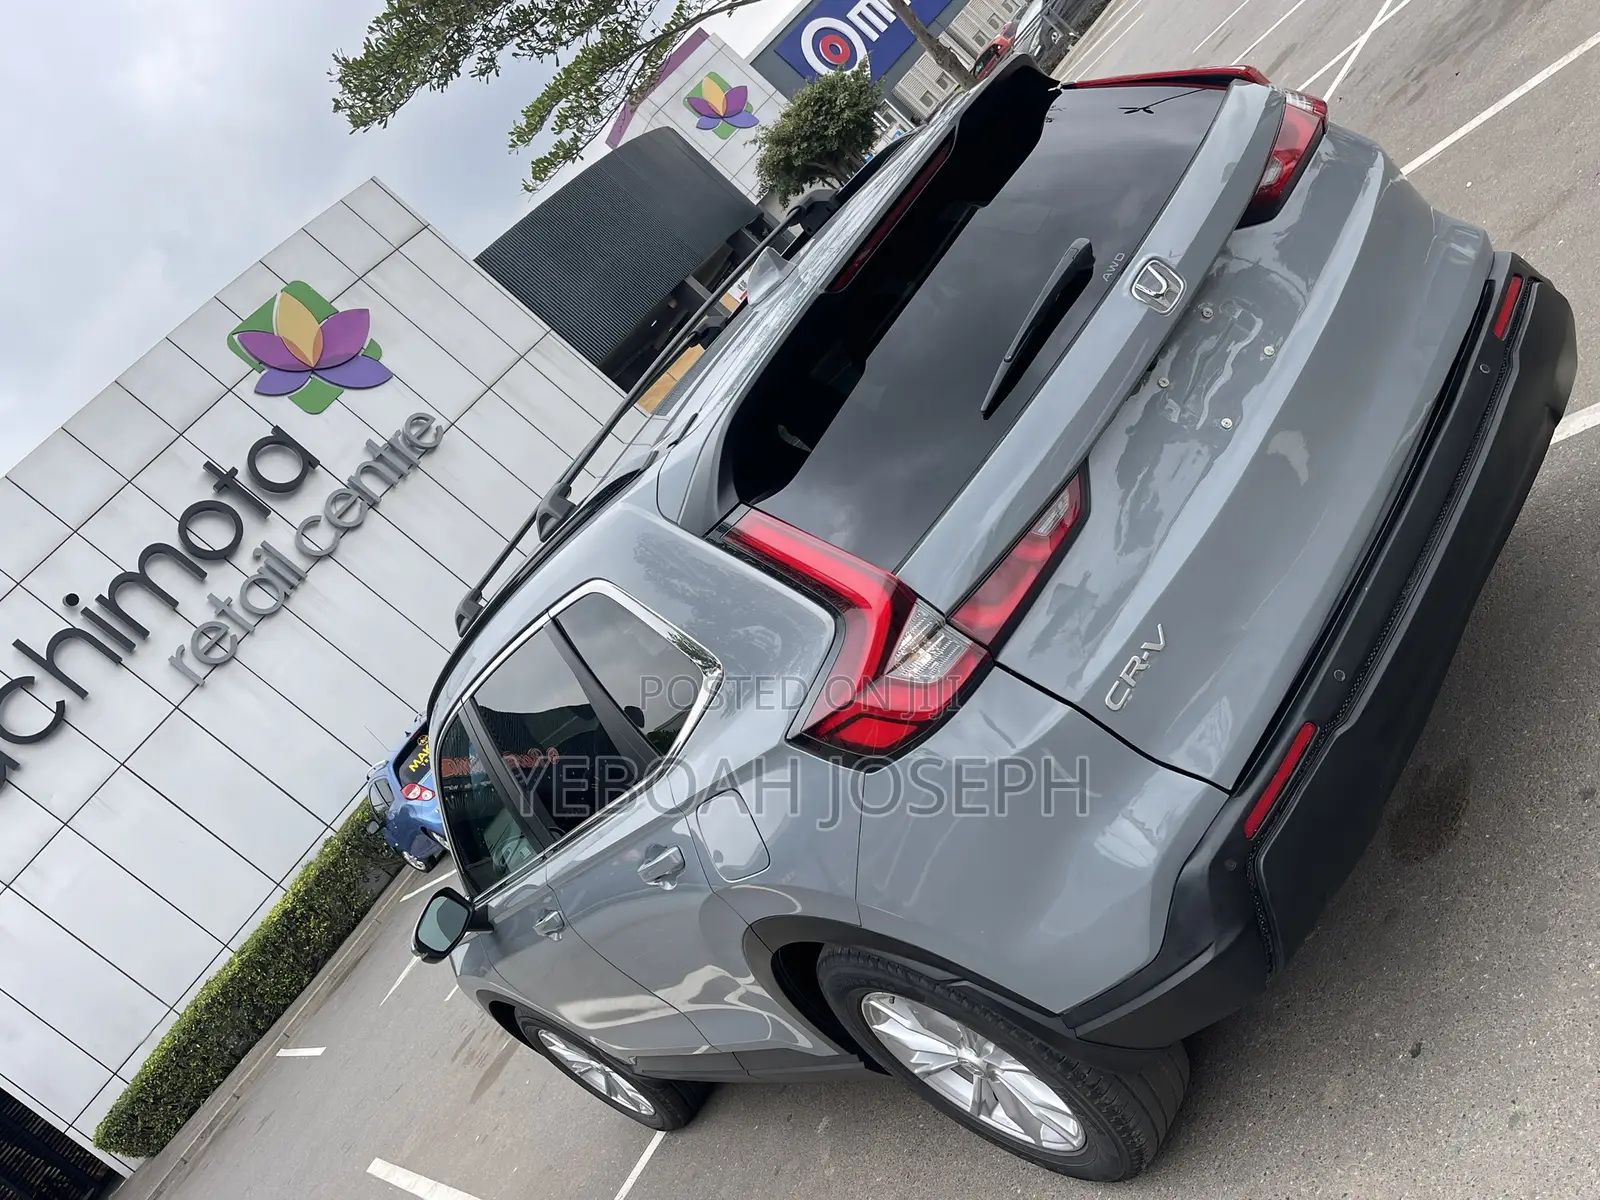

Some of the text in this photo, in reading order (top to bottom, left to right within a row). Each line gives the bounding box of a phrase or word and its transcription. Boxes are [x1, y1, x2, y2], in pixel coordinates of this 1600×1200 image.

[1102, 251, 1126, 282] AWD
[167, 412, 444, 687] retail centre
[1104, 623, 1165, 711] CR-V
